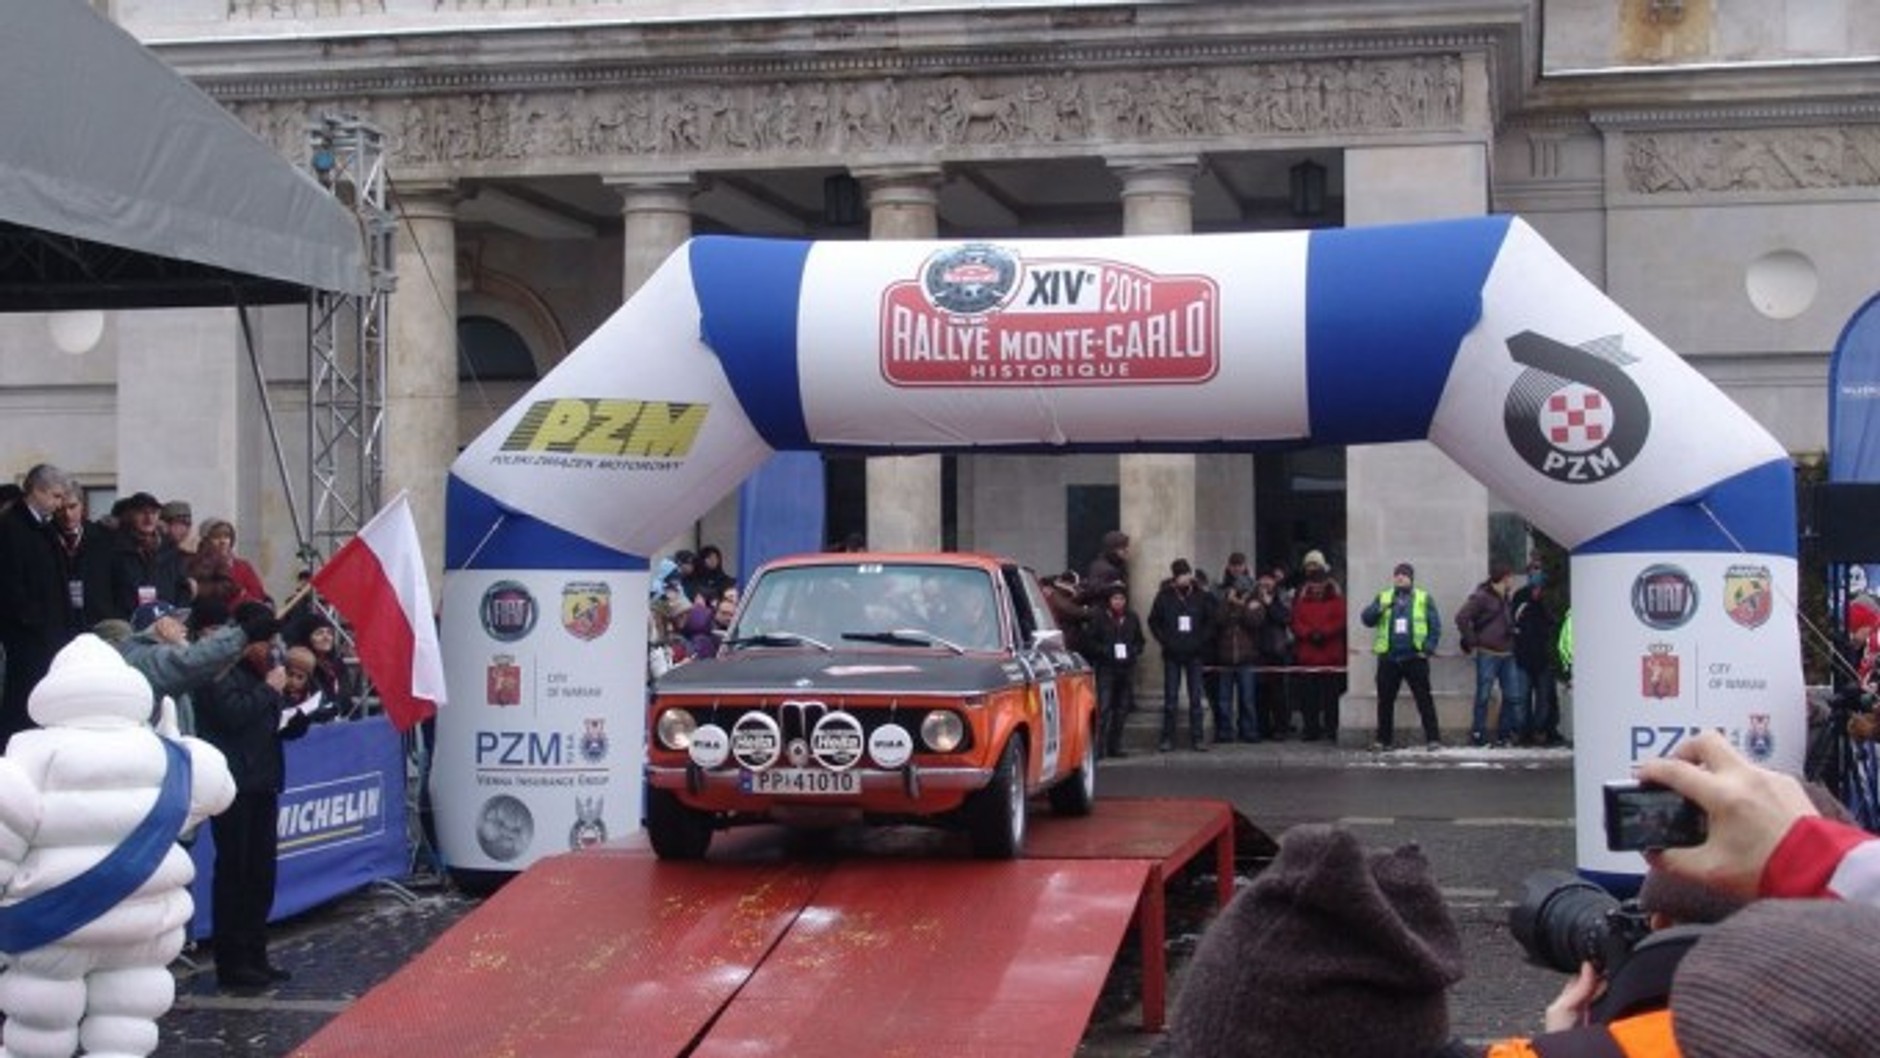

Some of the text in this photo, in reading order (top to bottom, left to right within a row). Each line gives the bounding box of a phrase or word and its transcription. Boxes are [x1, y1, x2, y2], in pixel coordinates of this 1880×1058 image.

[1104, 270, 1152, 313] 2011
[892, 299, 1207, 361] RALLYE MONTE-CARLO
[970, 362, 1130, 378] HISTORIQUE
[526, 398, 711, 457] PZM
[1542, 447, 1621, 480] PZM
[475, 731, 562, 766] PZM
[758, 772, 854, 791] PP 41010
[276, 787, 381, 838] MICHELIN
